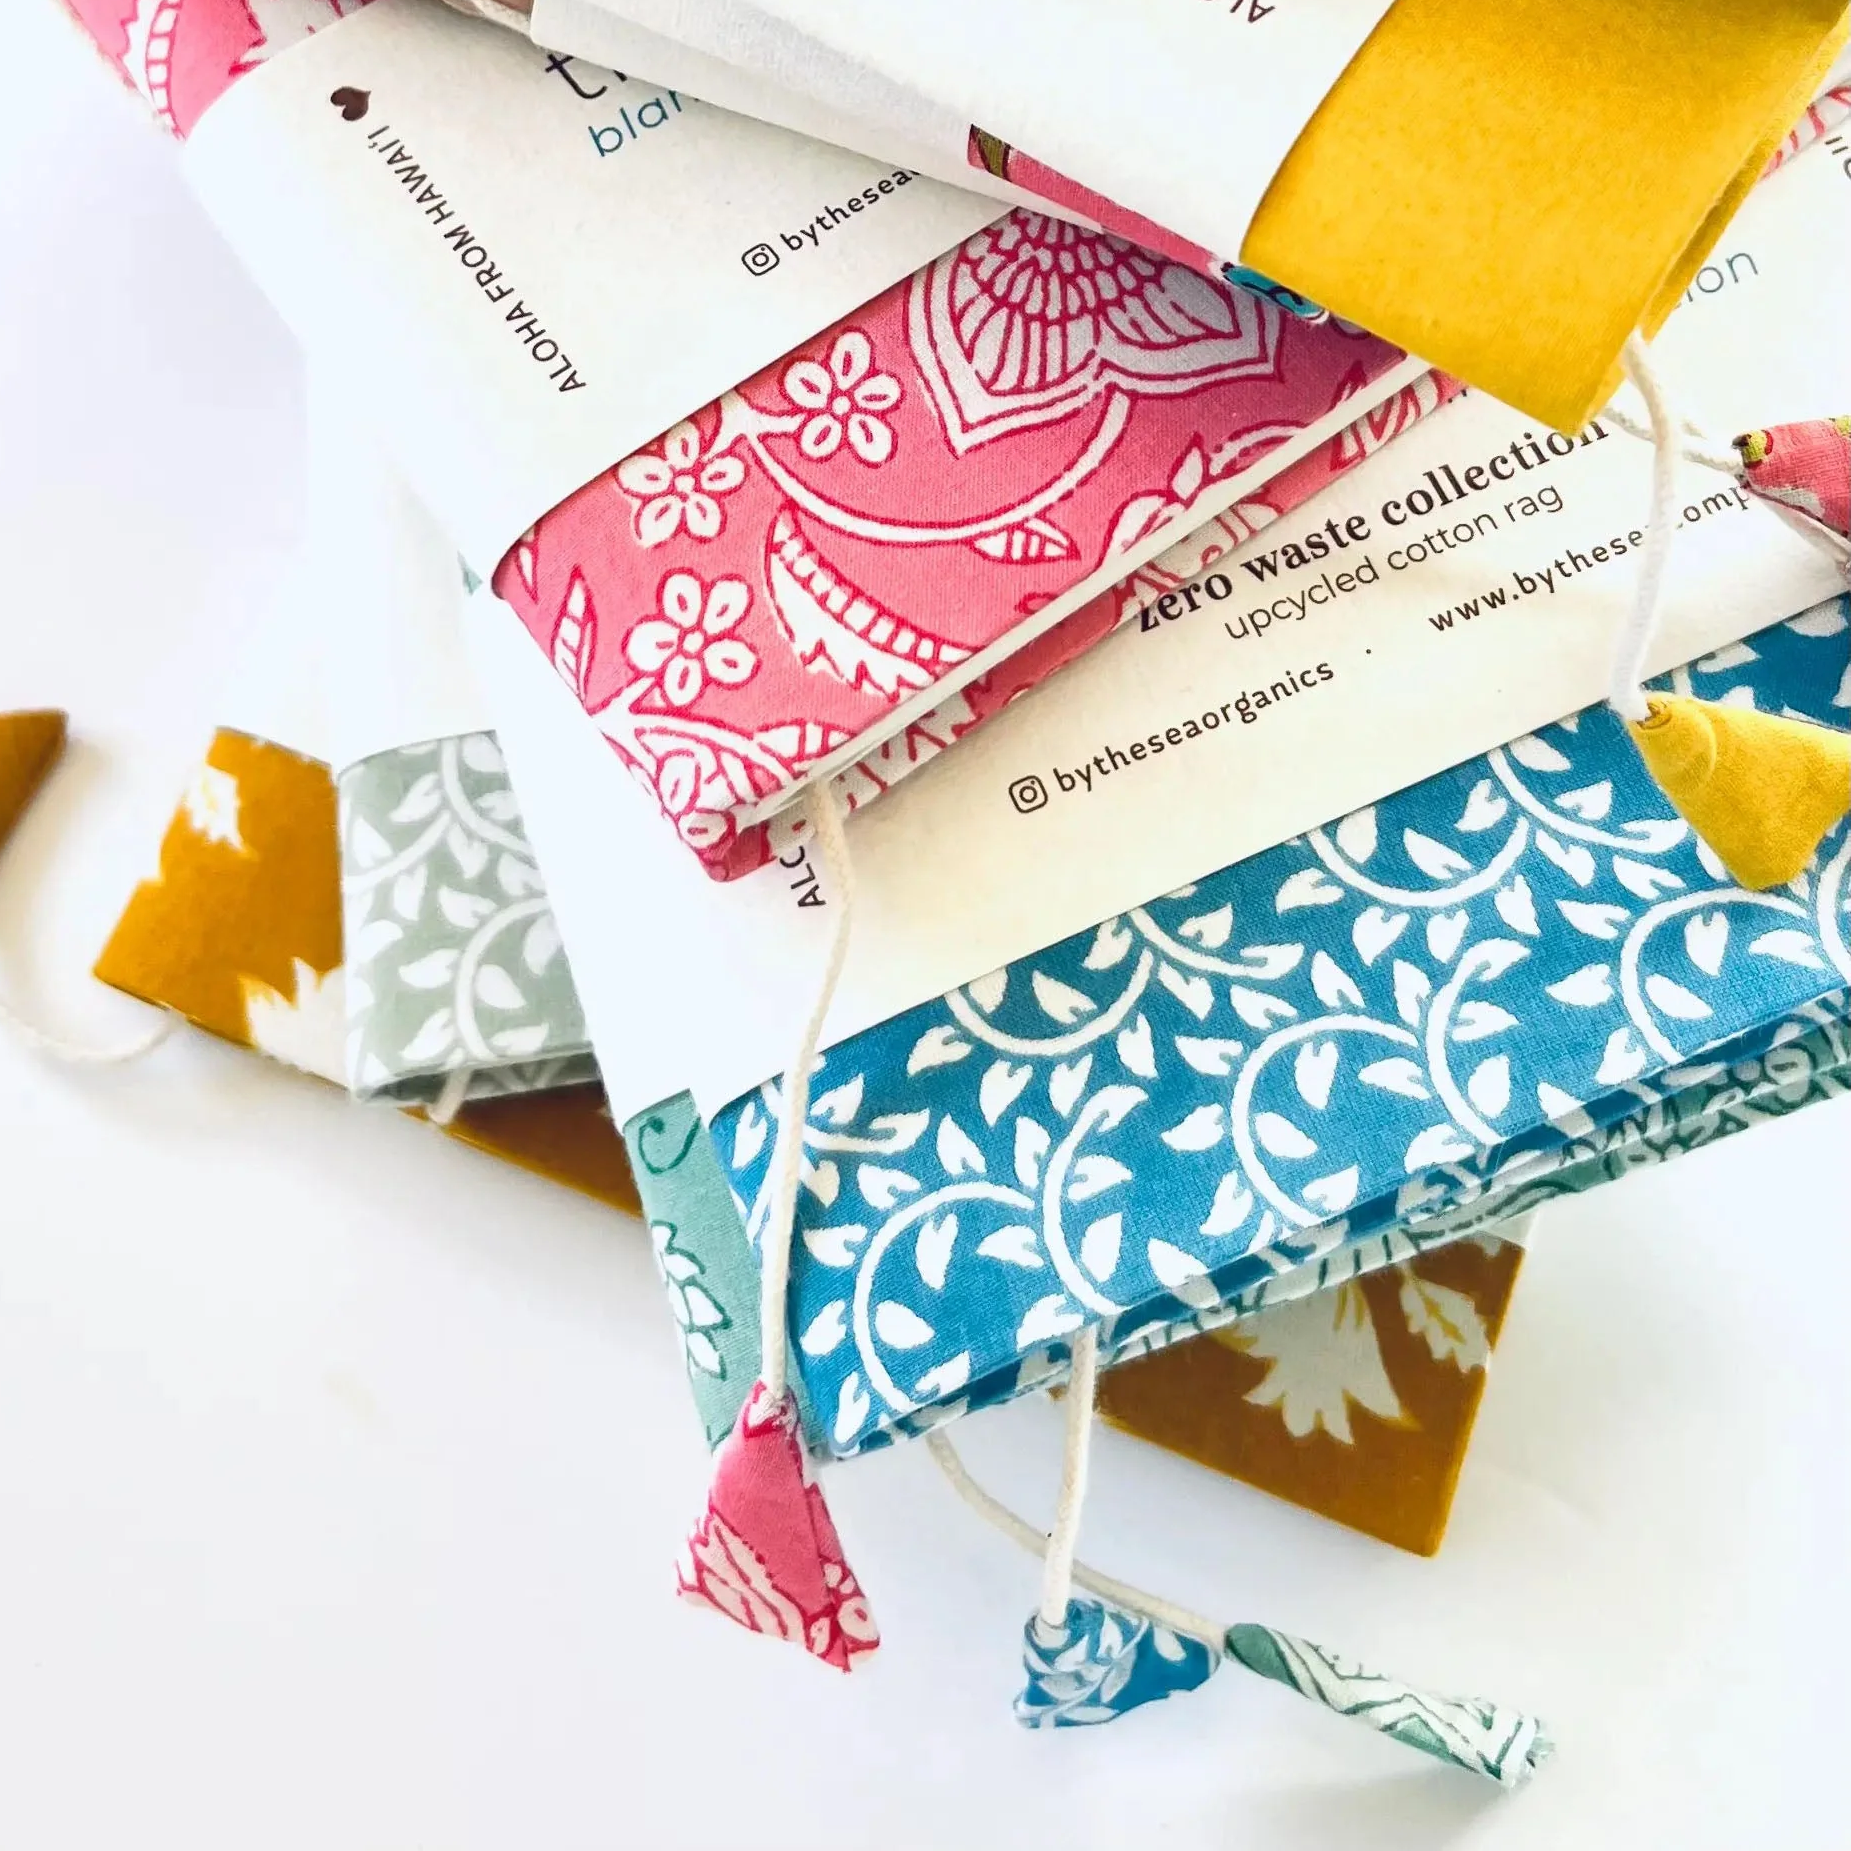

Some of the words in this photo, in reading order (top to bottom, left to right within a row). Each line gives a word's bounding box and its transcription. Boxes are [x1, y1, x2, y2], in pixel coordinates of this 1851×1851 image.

[444, 224, 515, 303] FROM
[506, 299, 587, 393] ALOHA
[1137, 573, 1234, 634] zero
[1239, 512, 1371, 593] waste
[1379, 421, 1610, 528] collection
[1223, 556, 1379, 643] upcycled
[1387, 512, 1499, 573] cotton
[1503, 484, 1564, 525] rag
[1053, 658, 1335, 794] bytheseaorganics
